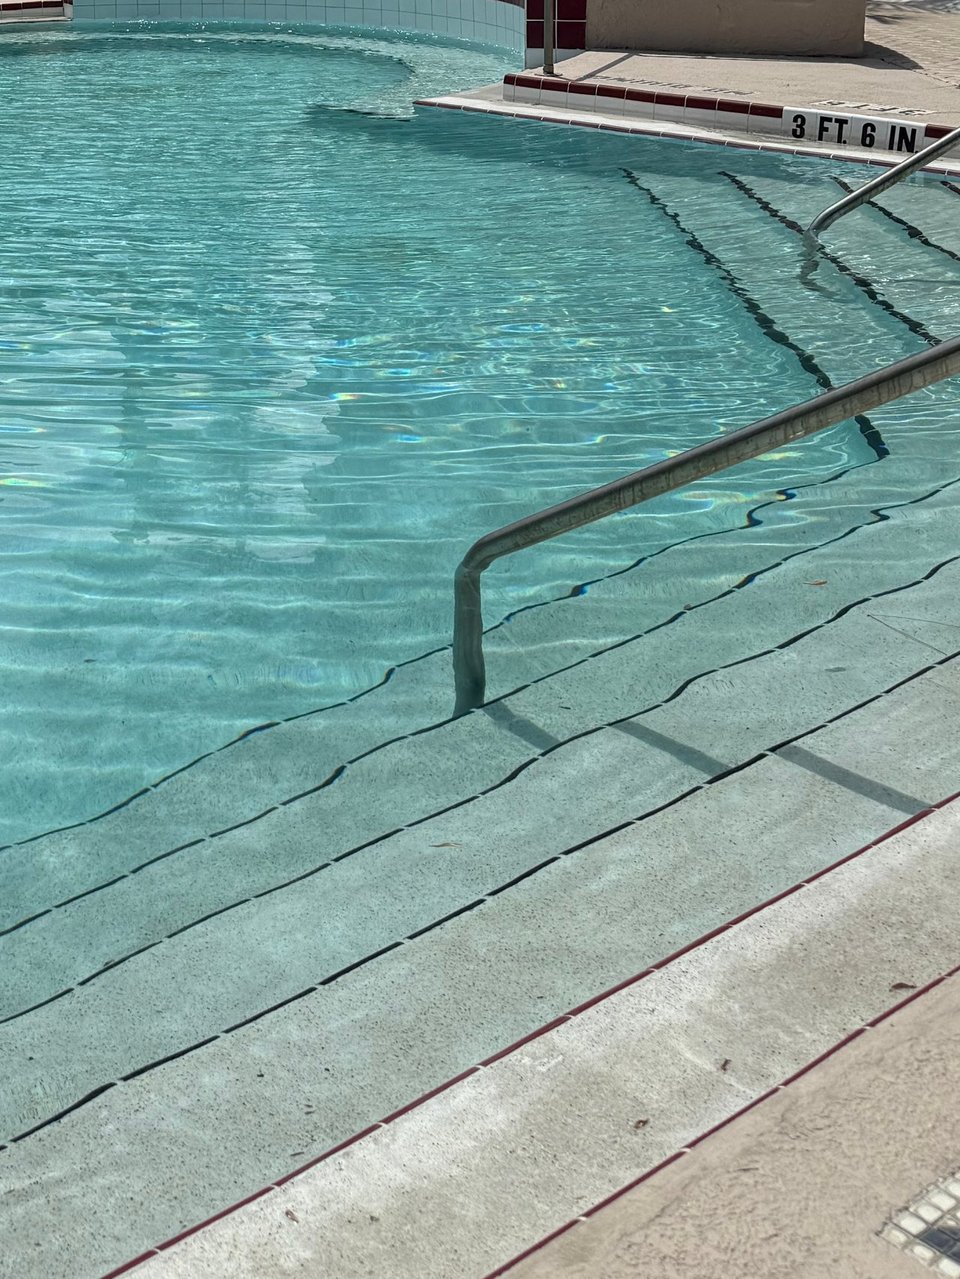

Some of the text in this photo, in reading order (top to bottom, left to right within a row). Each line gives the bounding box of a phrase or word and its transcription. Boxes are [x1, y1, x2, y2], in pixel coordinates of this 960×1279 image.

[791, 114, 806, 139] 3
[817, 115, 849, 145] FT.
[860, 122, 877, 148] 6
